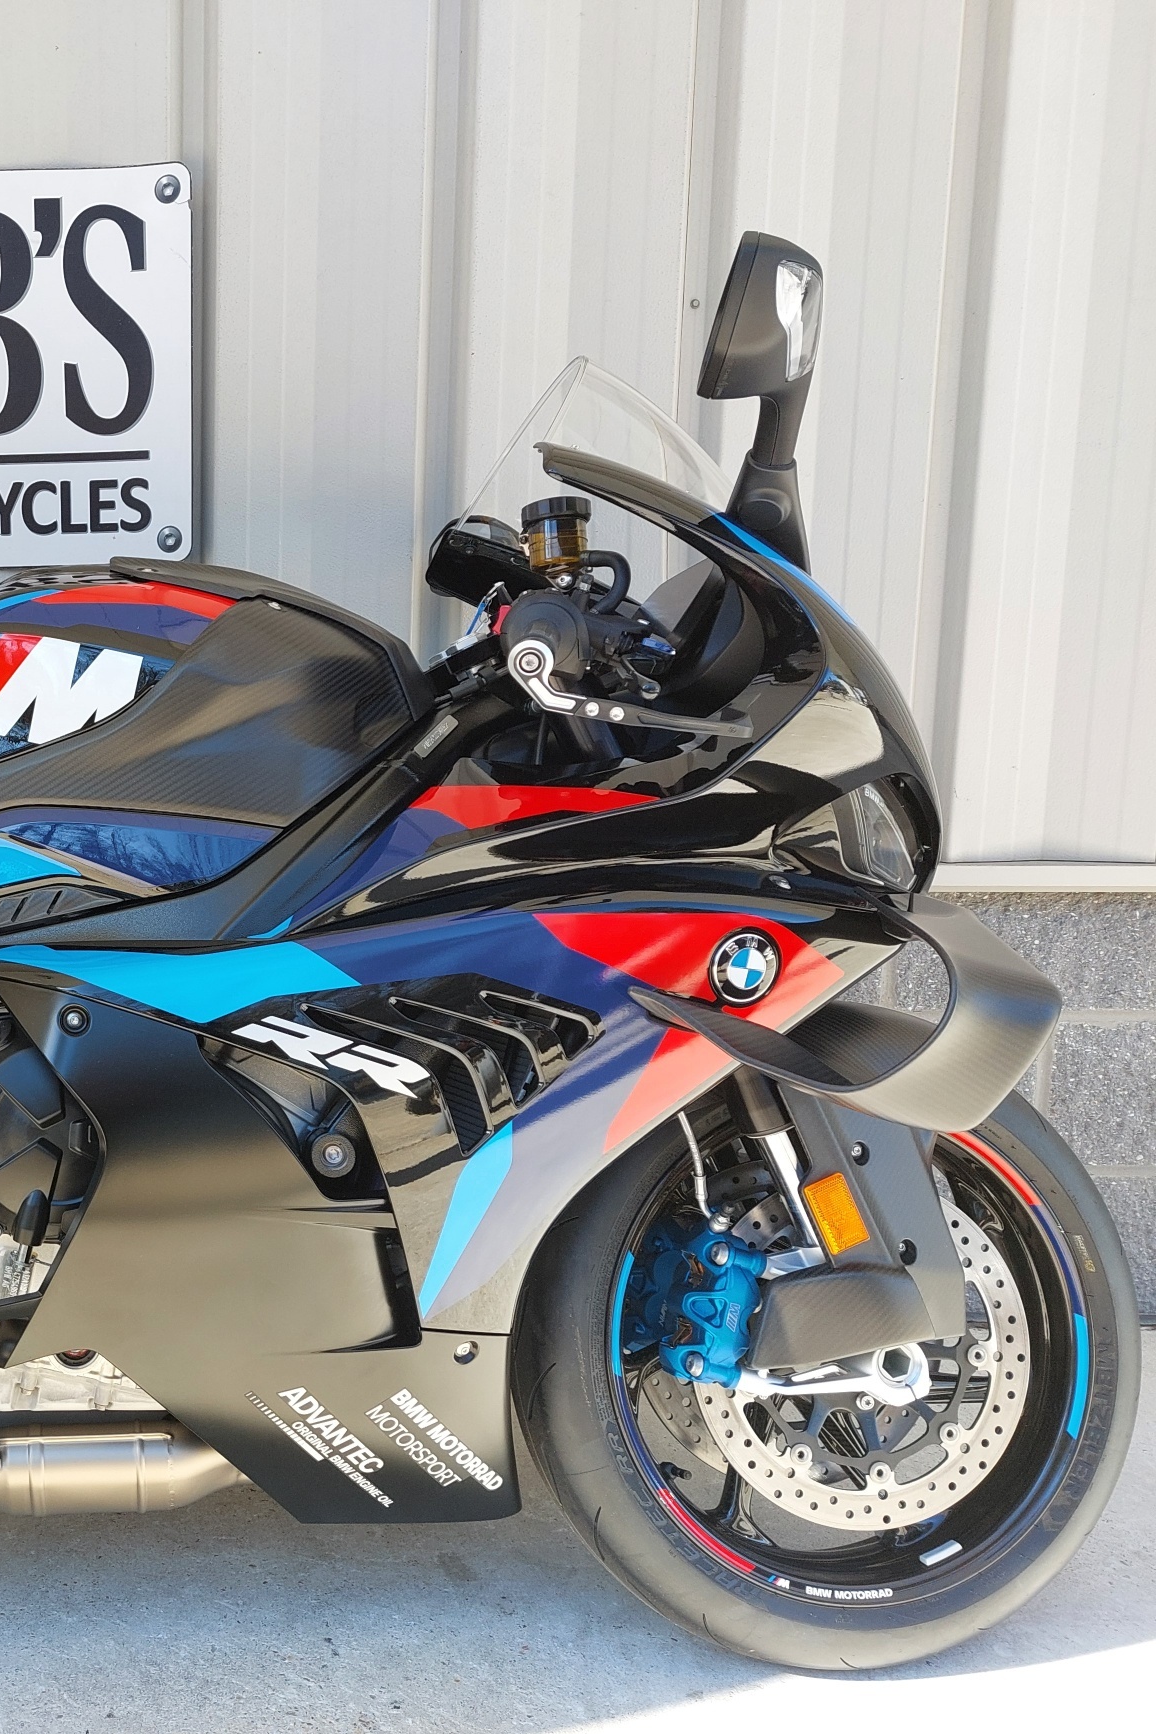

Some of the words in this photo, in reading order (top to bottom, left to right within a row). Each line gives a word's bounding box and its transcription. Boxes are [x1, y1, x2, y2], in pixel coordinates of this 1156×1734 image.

[725, 935, 775, 961] BMW
[231, 1015, 431, 1099] RR
[277, 1386, 385, 1474] ADVANTEC
[291, 1421, 333, 1459] ORIGINAL
[330, 1455, 351, 1475] BMW
[348, 1472, 383, 1500] ENGINE
[378, 1495, 395, 1508] OIL
[364, 1404, 462, 1488] MOTORSPORT
[390, 1387, 437, 1430] BMW
[428, 1423, 504, 1491] MOTORRAD
[805, 1586, 832, 1598] BMW
[834, 1588, 893, 1600] MOTORRAD
